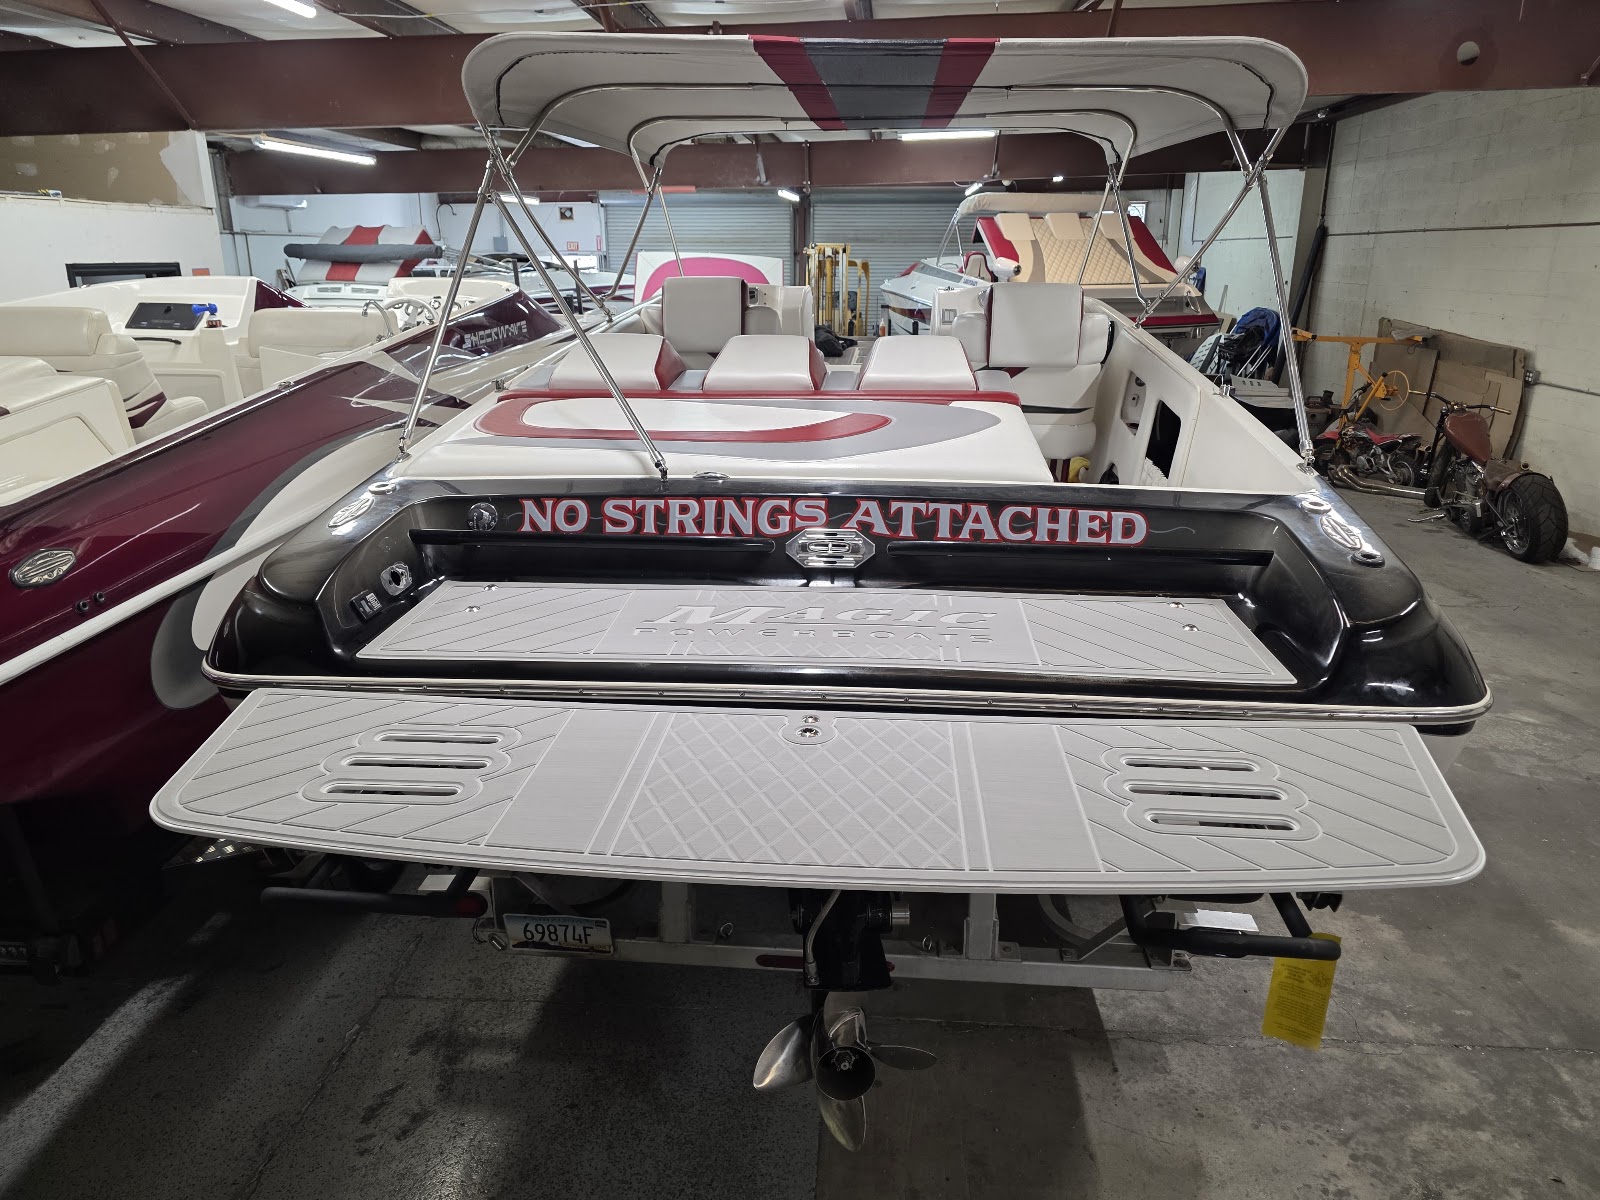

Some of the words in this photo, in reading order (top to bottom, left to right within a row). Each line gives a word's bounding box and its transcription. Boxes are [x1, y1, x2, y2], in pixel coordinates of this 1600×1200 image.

[463, 320, 528, 349] SHOCKWAVE
[517, 498, 589, 535] NO
[601, 497, 829, 538] STRINGS
[841, 499, 1148, 546] ATTACHED
[641, 604, 998, 627] MAGIC
[633, 627, 994, 644] POWERBOATS
[523, 922, 594, 944] 69874F
